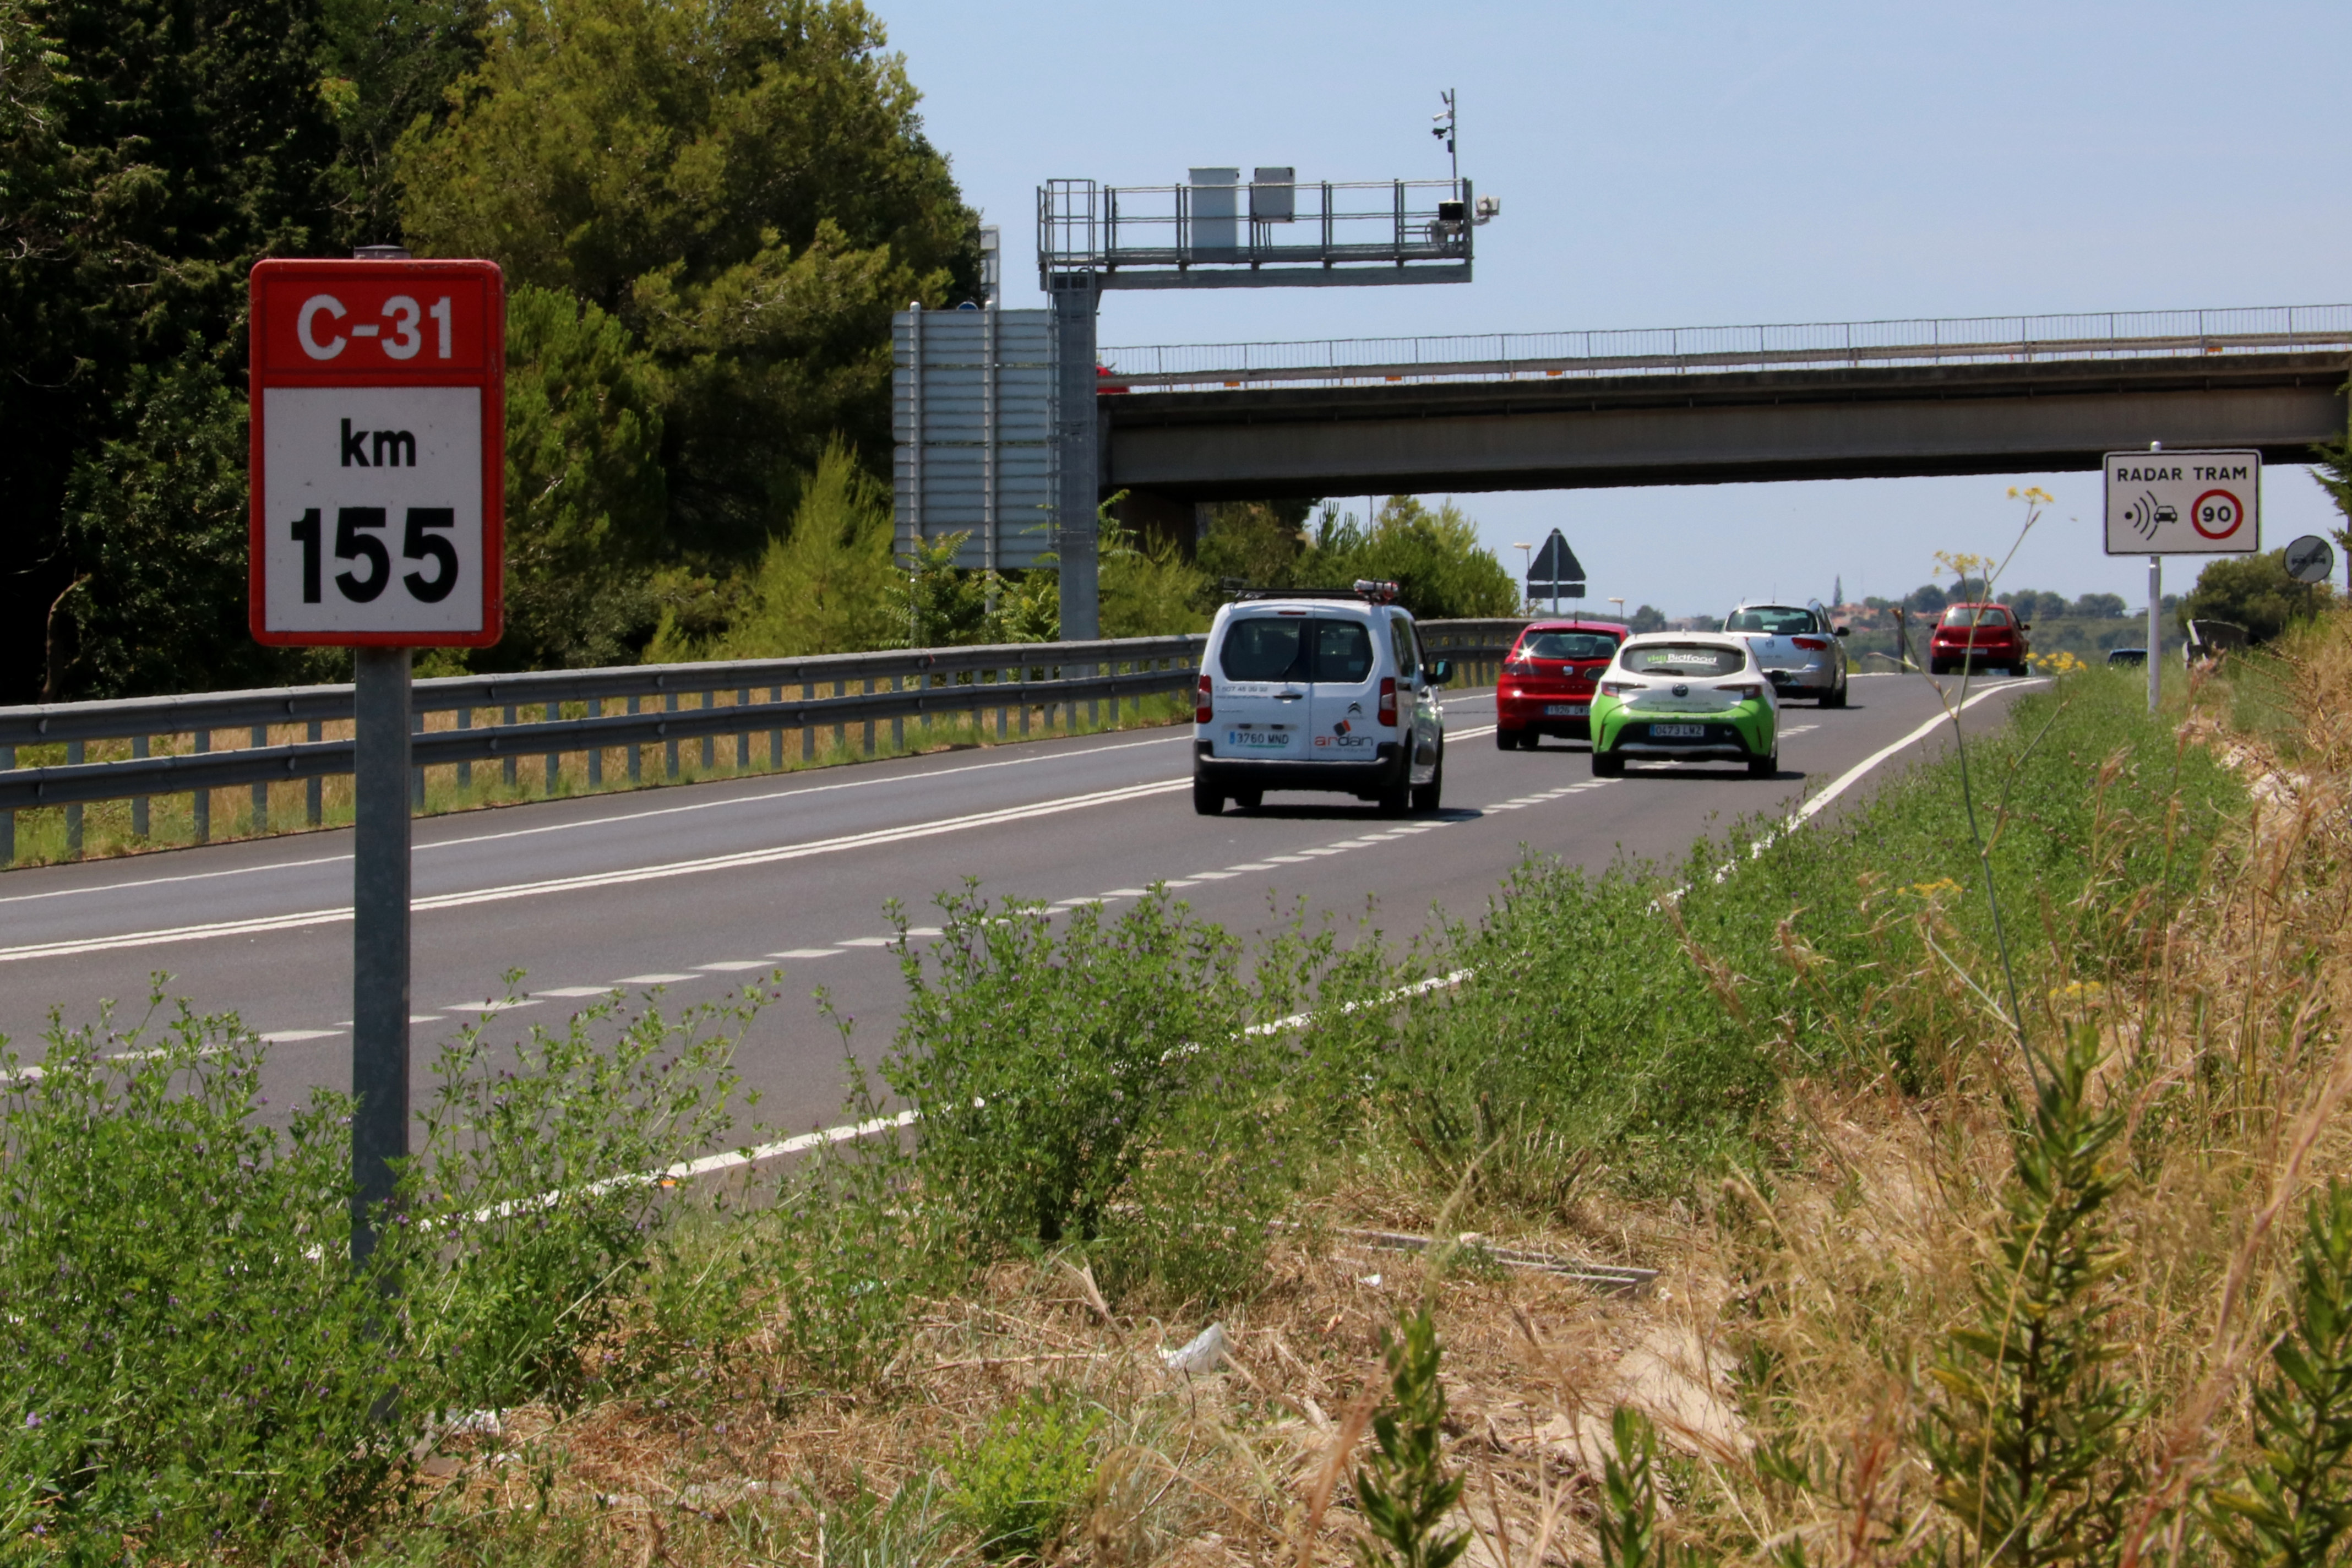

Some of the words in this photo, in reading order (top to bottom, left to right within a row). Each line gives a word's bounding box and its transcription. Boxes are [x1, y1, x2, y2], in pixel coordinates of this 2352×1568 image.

[296, 293, 453, 361] C-31
[340, 417, 417, 467] km
[2117, 467, 2183, 482] RADAR
[2193, 466, 2247, 481] TRAM
[2202, 505, 2231, 522] 90
[290, 507, 459, 604] 155
[1268, 733, 1289, 744] MND
[1314, 733, 1374, 747] ardan
